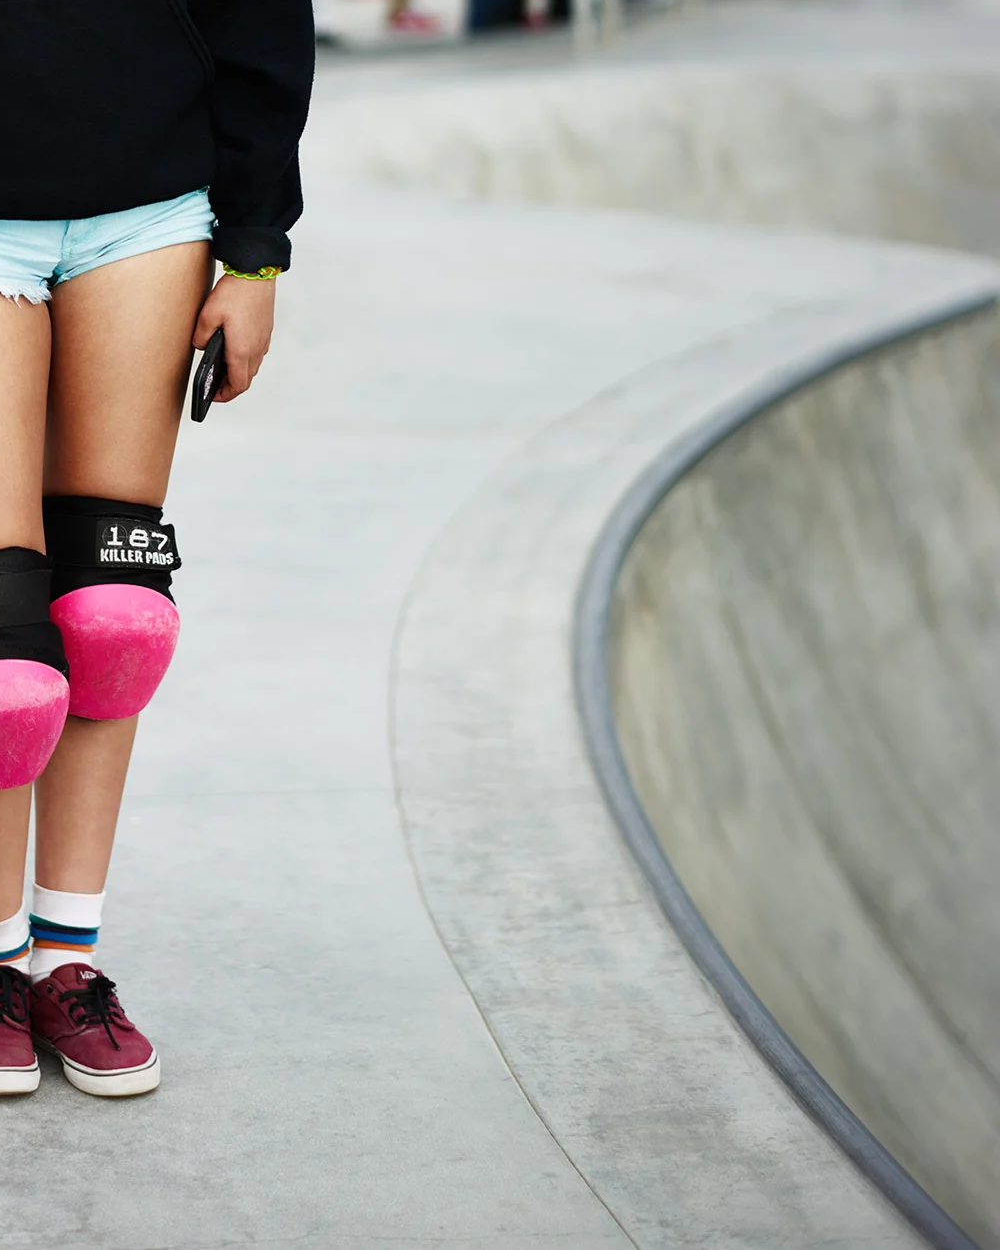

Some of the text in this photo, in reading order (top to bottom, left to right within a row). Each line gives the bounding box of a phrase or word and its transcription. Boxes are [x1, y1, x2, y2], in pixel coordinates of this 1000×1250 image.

[107, 526, 169, 551] 187
[100, 548, 174, 565] KILLER PADS
